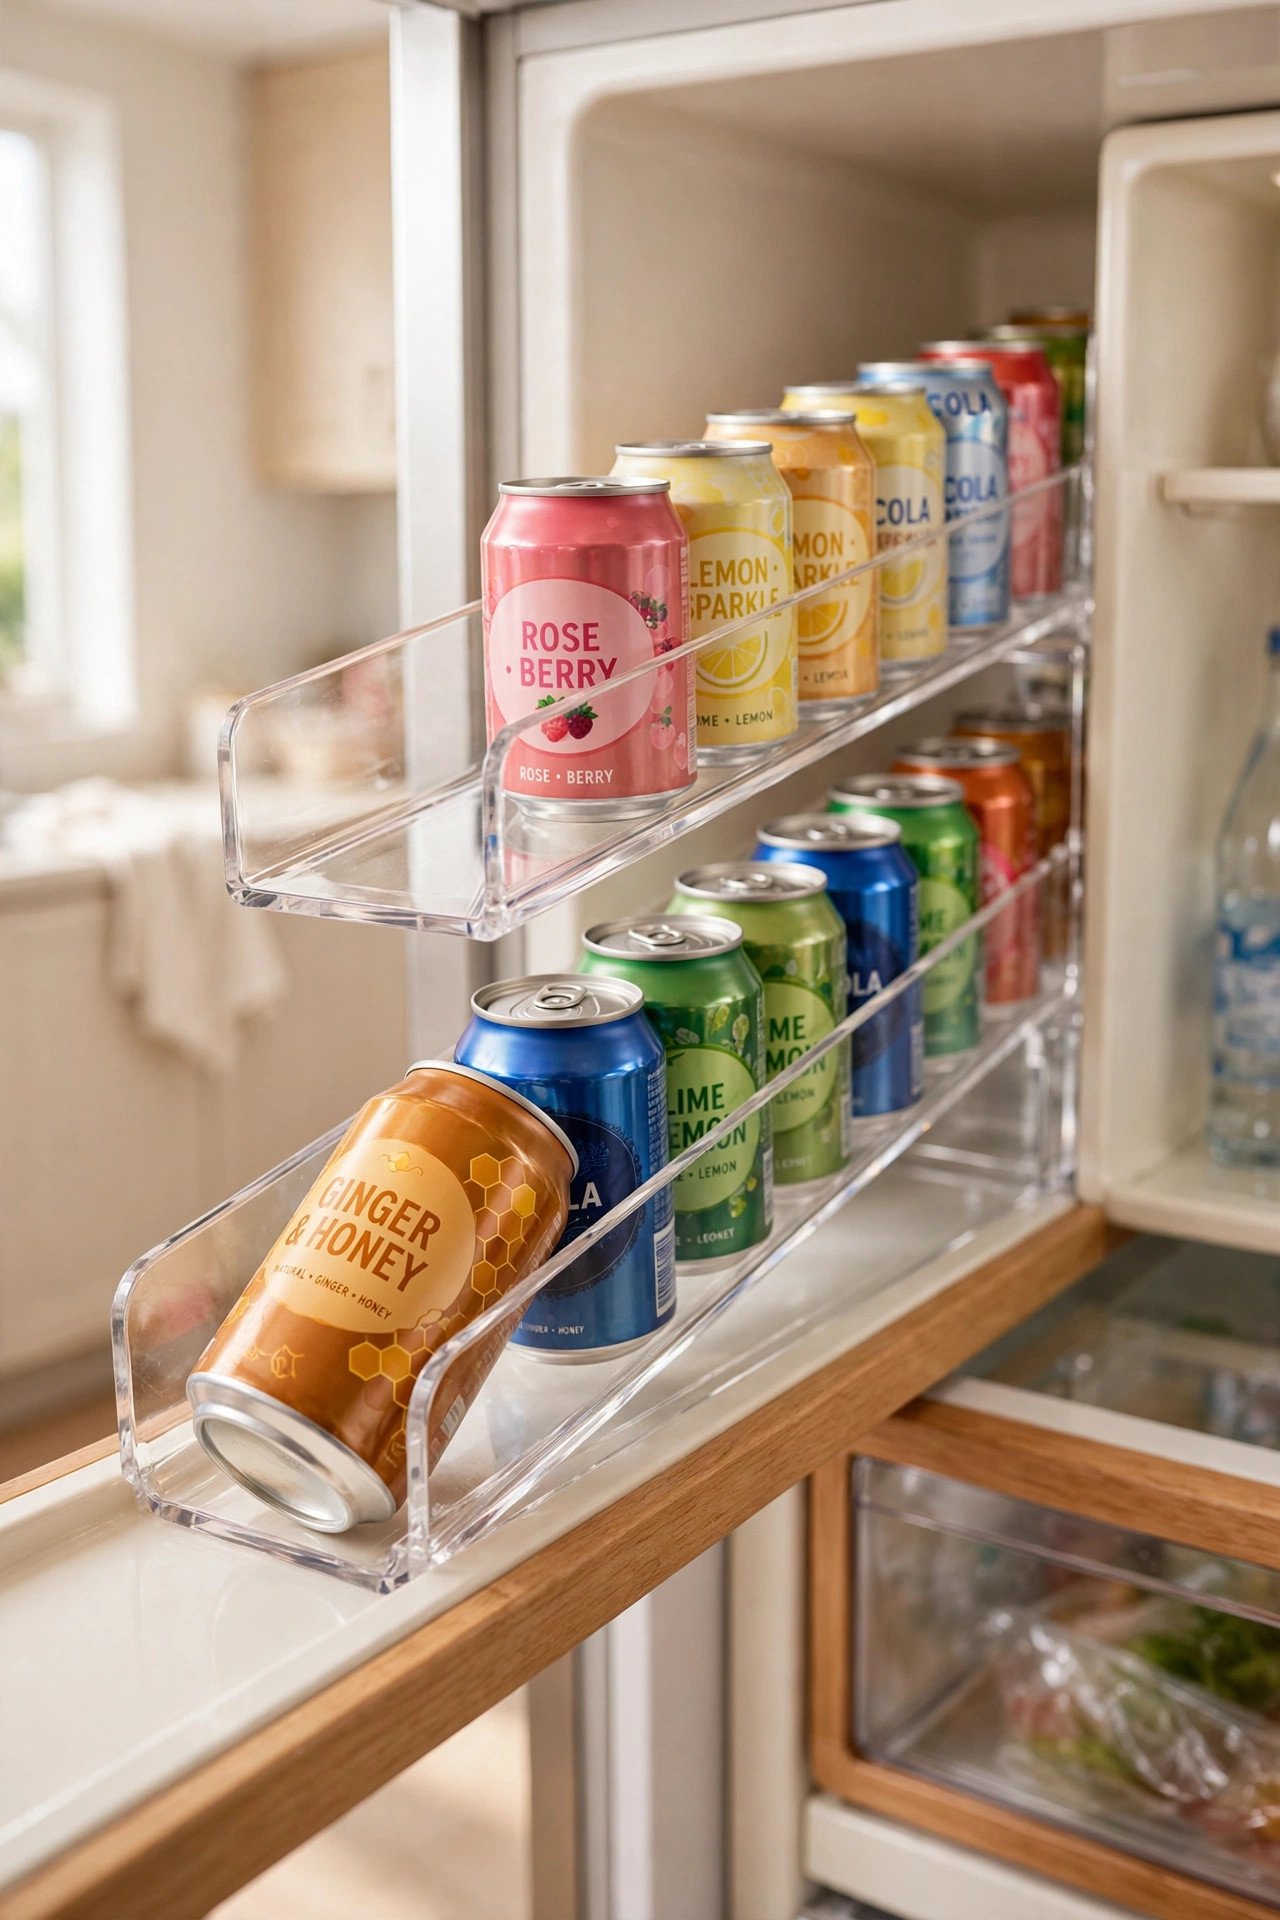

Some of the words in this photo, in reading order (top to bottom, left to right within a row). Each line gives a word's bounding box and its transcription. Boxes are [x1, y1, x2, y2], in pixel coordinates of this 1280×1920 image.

[927, 390, 992, 417] COLA
[944, 475, 998, 505] COLA
[876, 497, 930, 526] COLA
[793, 532, 843, 558] MON
[522, 620, 600, 652] ROSE
[520, 657, 618, 689] BERRY
[736, 709, 773, 726] LEMON
[520, 765, 550, 783] ROSE
[567, 769, 614, 785] BERRY
[841, 969, 882, 997] OLA
[769, 1015, 806, 1042] ME
[766, 1046, 825, 1076] MON
[669, 1113, 746, 1152] EMON
[699, 1161, 737, 1179] LEMON
[568, 1181, 603, 1211] LA
[318, 1176, 441, 1251] GINGER
[285, 1214, 310, 1246] &
[305, 1216, 429, 1292] HONEY
[314, 1274, 350, 1298] GINGER
[357, 1294, 393, 1321] HONEY
